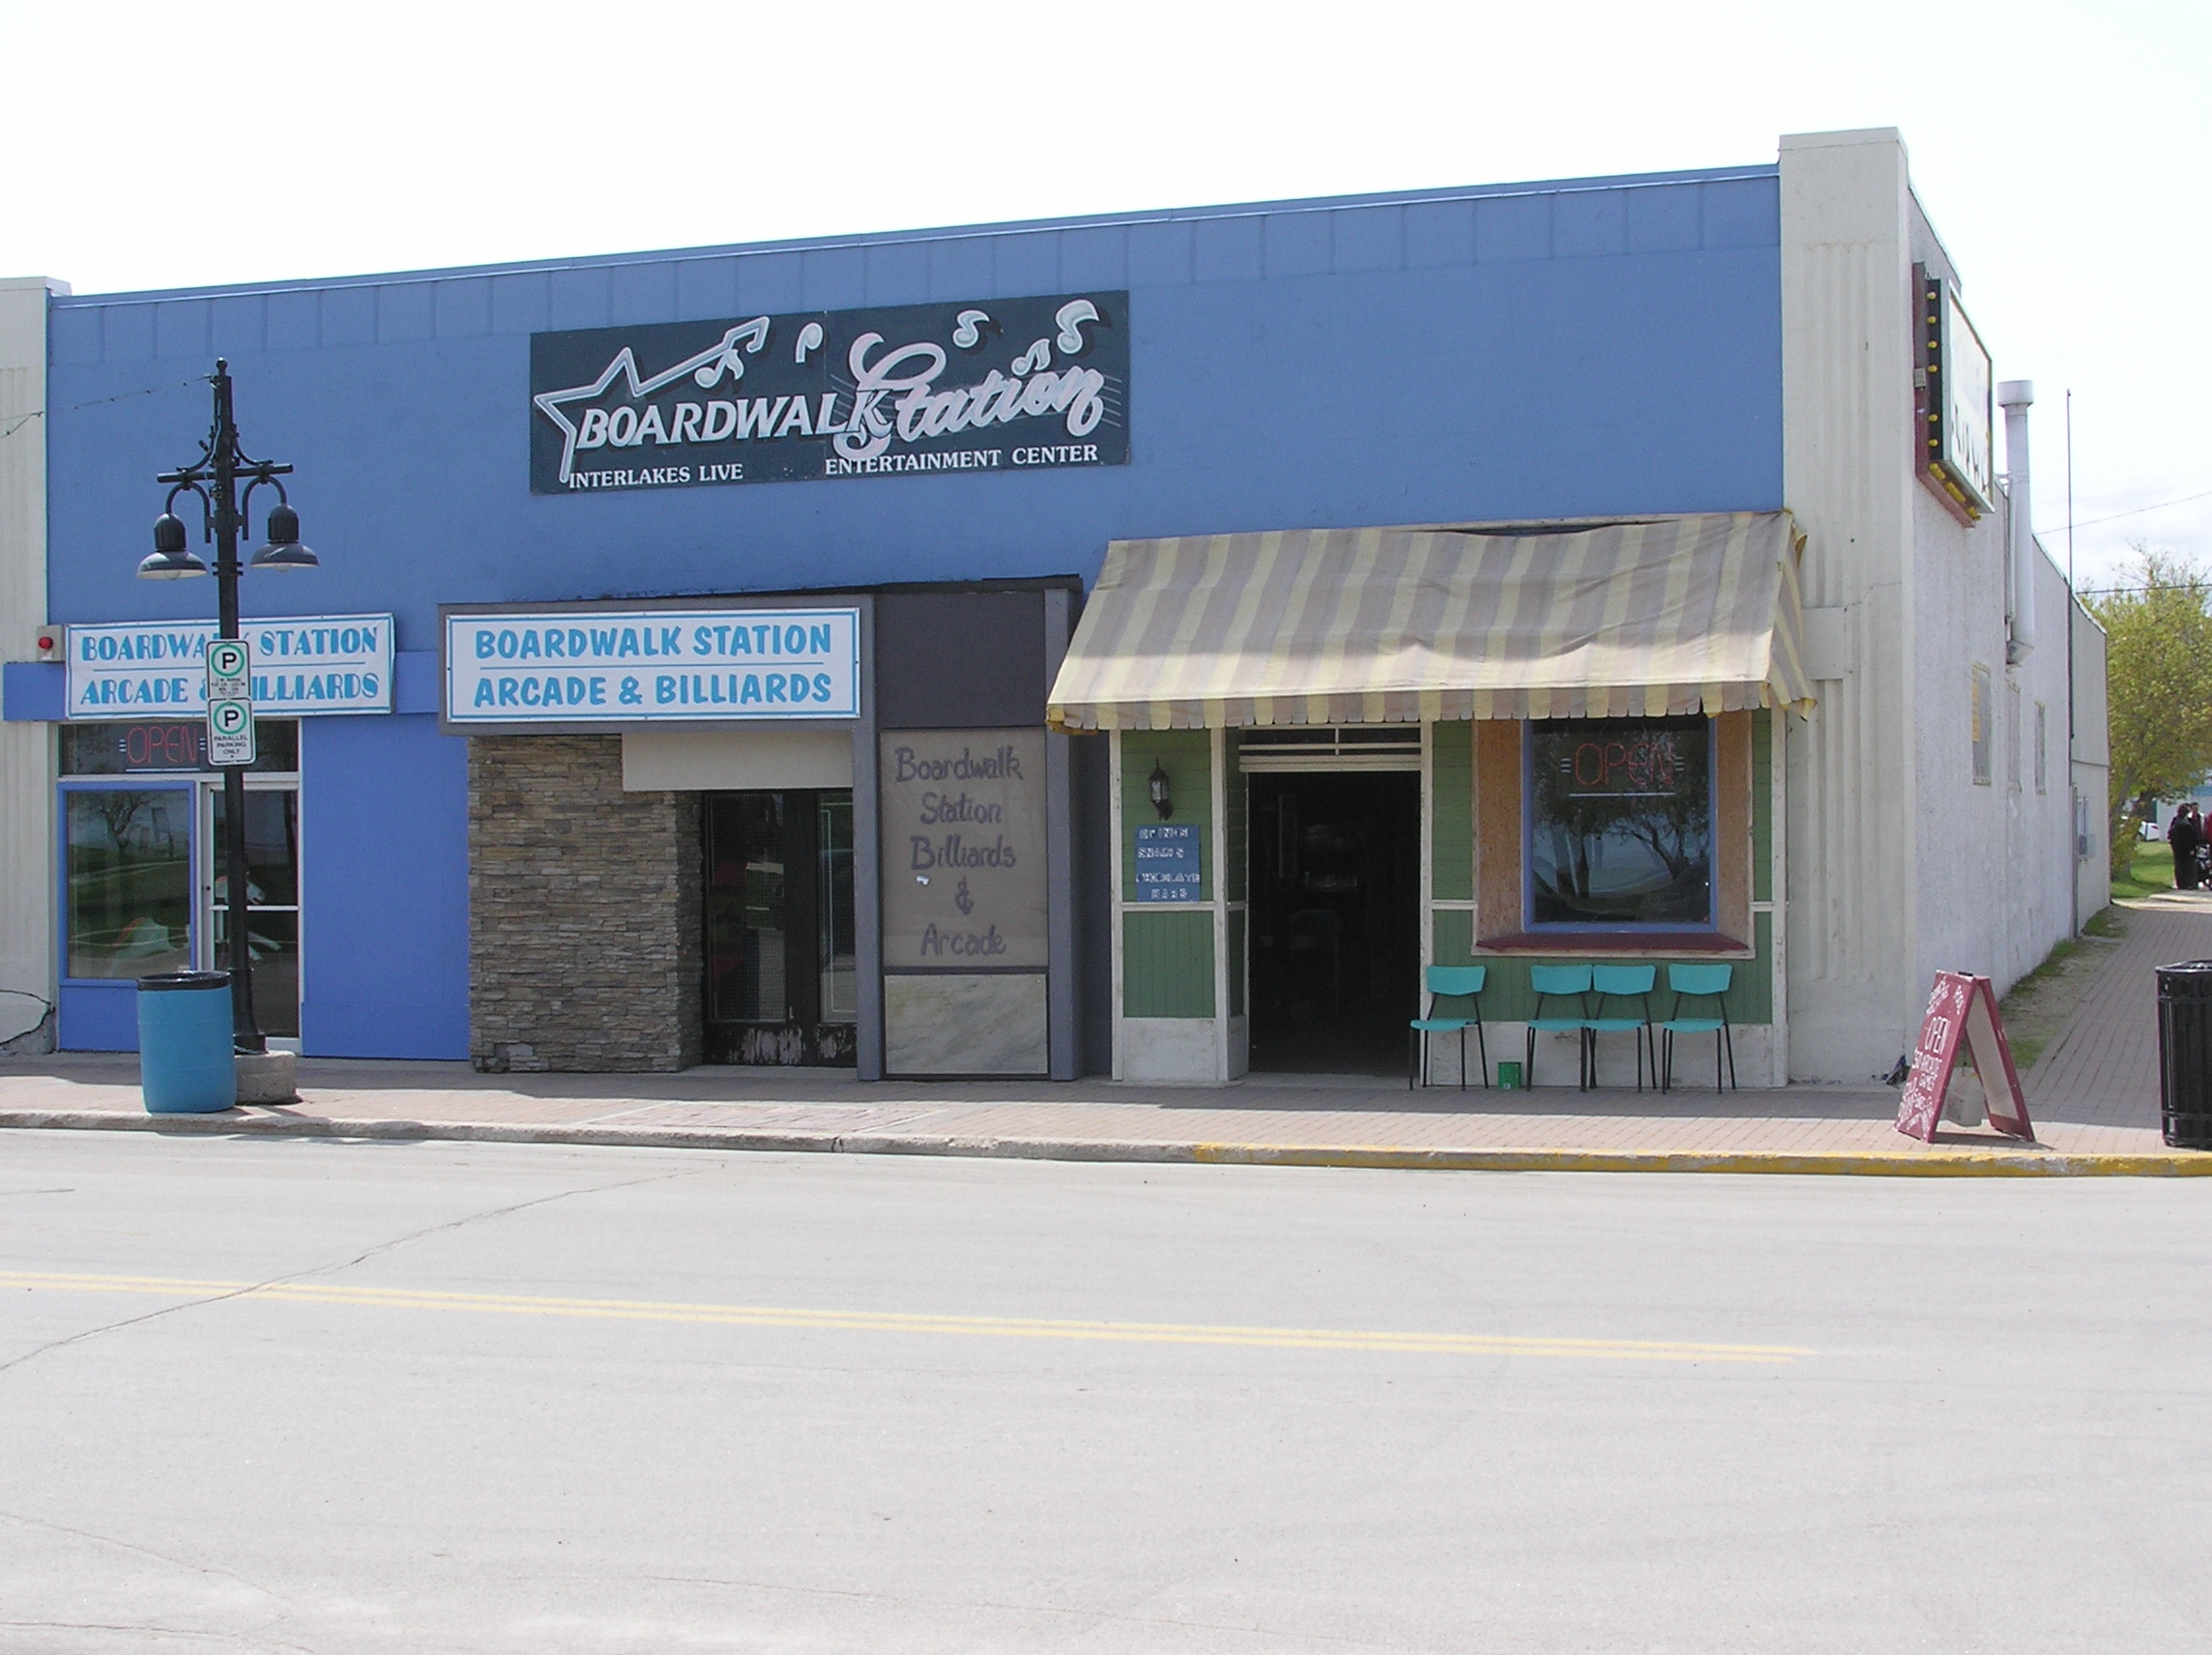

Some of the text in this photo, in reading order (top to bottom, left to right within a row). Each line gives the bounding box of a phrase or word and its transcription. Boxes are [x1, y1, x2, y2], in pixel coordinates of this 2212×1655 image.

[575, 332, 1104, 460] BOARDWALK Station
[568, 462, 743, 488] INTERLAKES LIVE
[825, 444, 1099, 476] ENTERTAINMENT CENTER
[81, 626, 377, 661] BOARDWA STATION
[475, 624, 831, 659] BOARDWALK STATION
[80, 678, 189, 705] ARCADE
[251, 672, 380, 702] ILLIARDS
[474, 673, 831, 708] ARCADE & BILLIARDS
[127, 725, 198, 764] OPEN
[894, 743, 1024, 782] Boardwalk
[1575, 741, 1675, 786] OPEN
[919, 791, 1003, 825] Station
[910, 832, 1016, 870] Billiards
[954, 875, 975, 915] &
[919, 921, 1006, 957] Arcade
